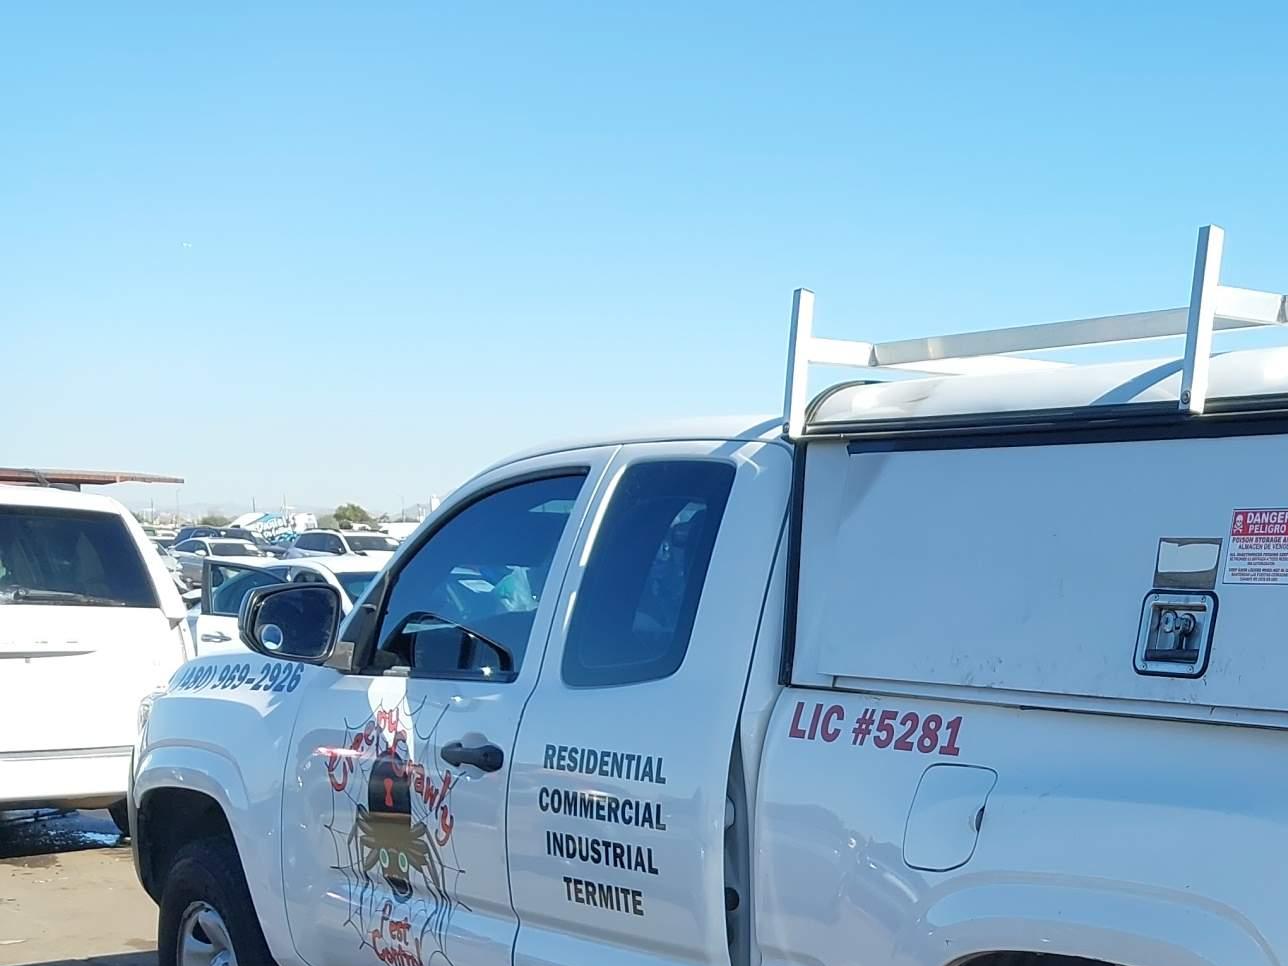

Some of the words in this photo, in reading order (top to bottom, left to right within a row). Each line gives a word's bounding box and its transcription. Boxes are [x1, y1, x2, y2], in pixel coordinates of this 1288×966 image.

[1248, 524, 1287, 534] PELIGRO
[170, 664, 218, 693] (480)
[211, 662, 305, 692] 969-2926
[788, 701, 845, 742] LIC
[851, 708, 963, 756] #5281
[543, 744, 667, 784] RESIDENTIAL
[538, 787, 667, 831] COMMERCIAL
[546, 830, 659, 875] INDUSTRIAL
[563, 876, 645, 916] TERMITE
[381, 899, 411, 946] Pest
